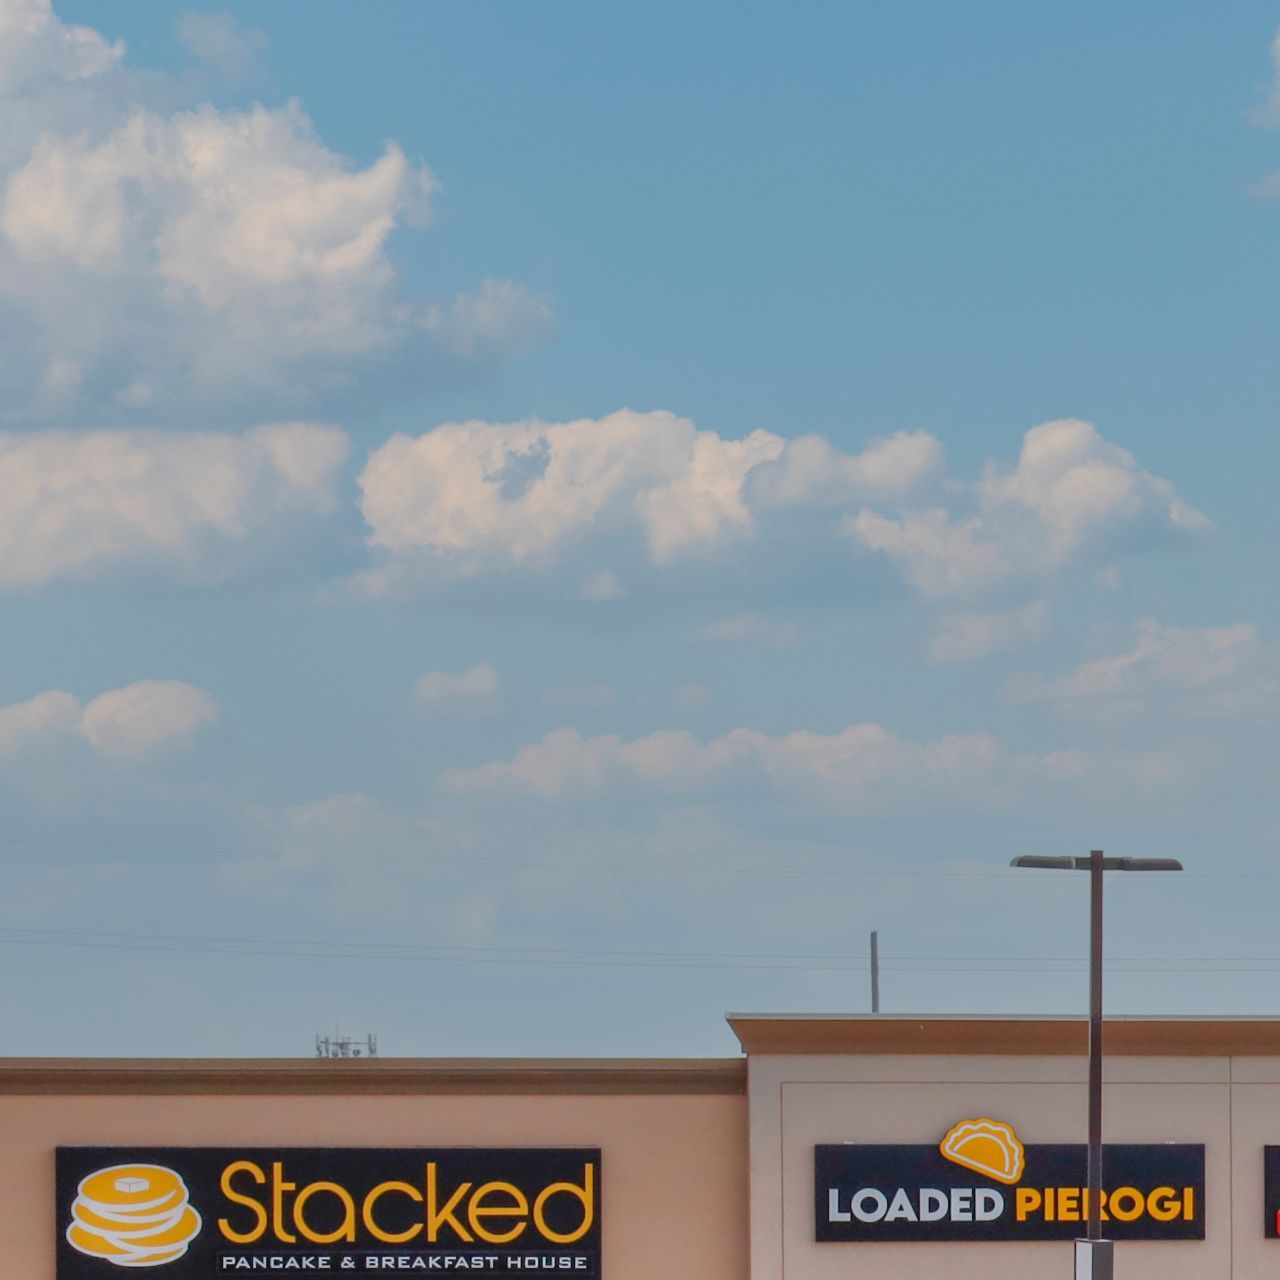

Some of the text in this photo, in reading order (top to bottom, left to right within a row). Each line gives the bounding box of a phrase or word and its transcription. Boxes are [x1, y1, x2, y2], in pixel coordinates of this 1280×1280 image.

[217, 1160, 594, 1245] Stacked
[828, 1187, 1005, 1222] LOADED
[222, 1255, 588, 1270] PANCAKE & BREAKFAST HOUSE
